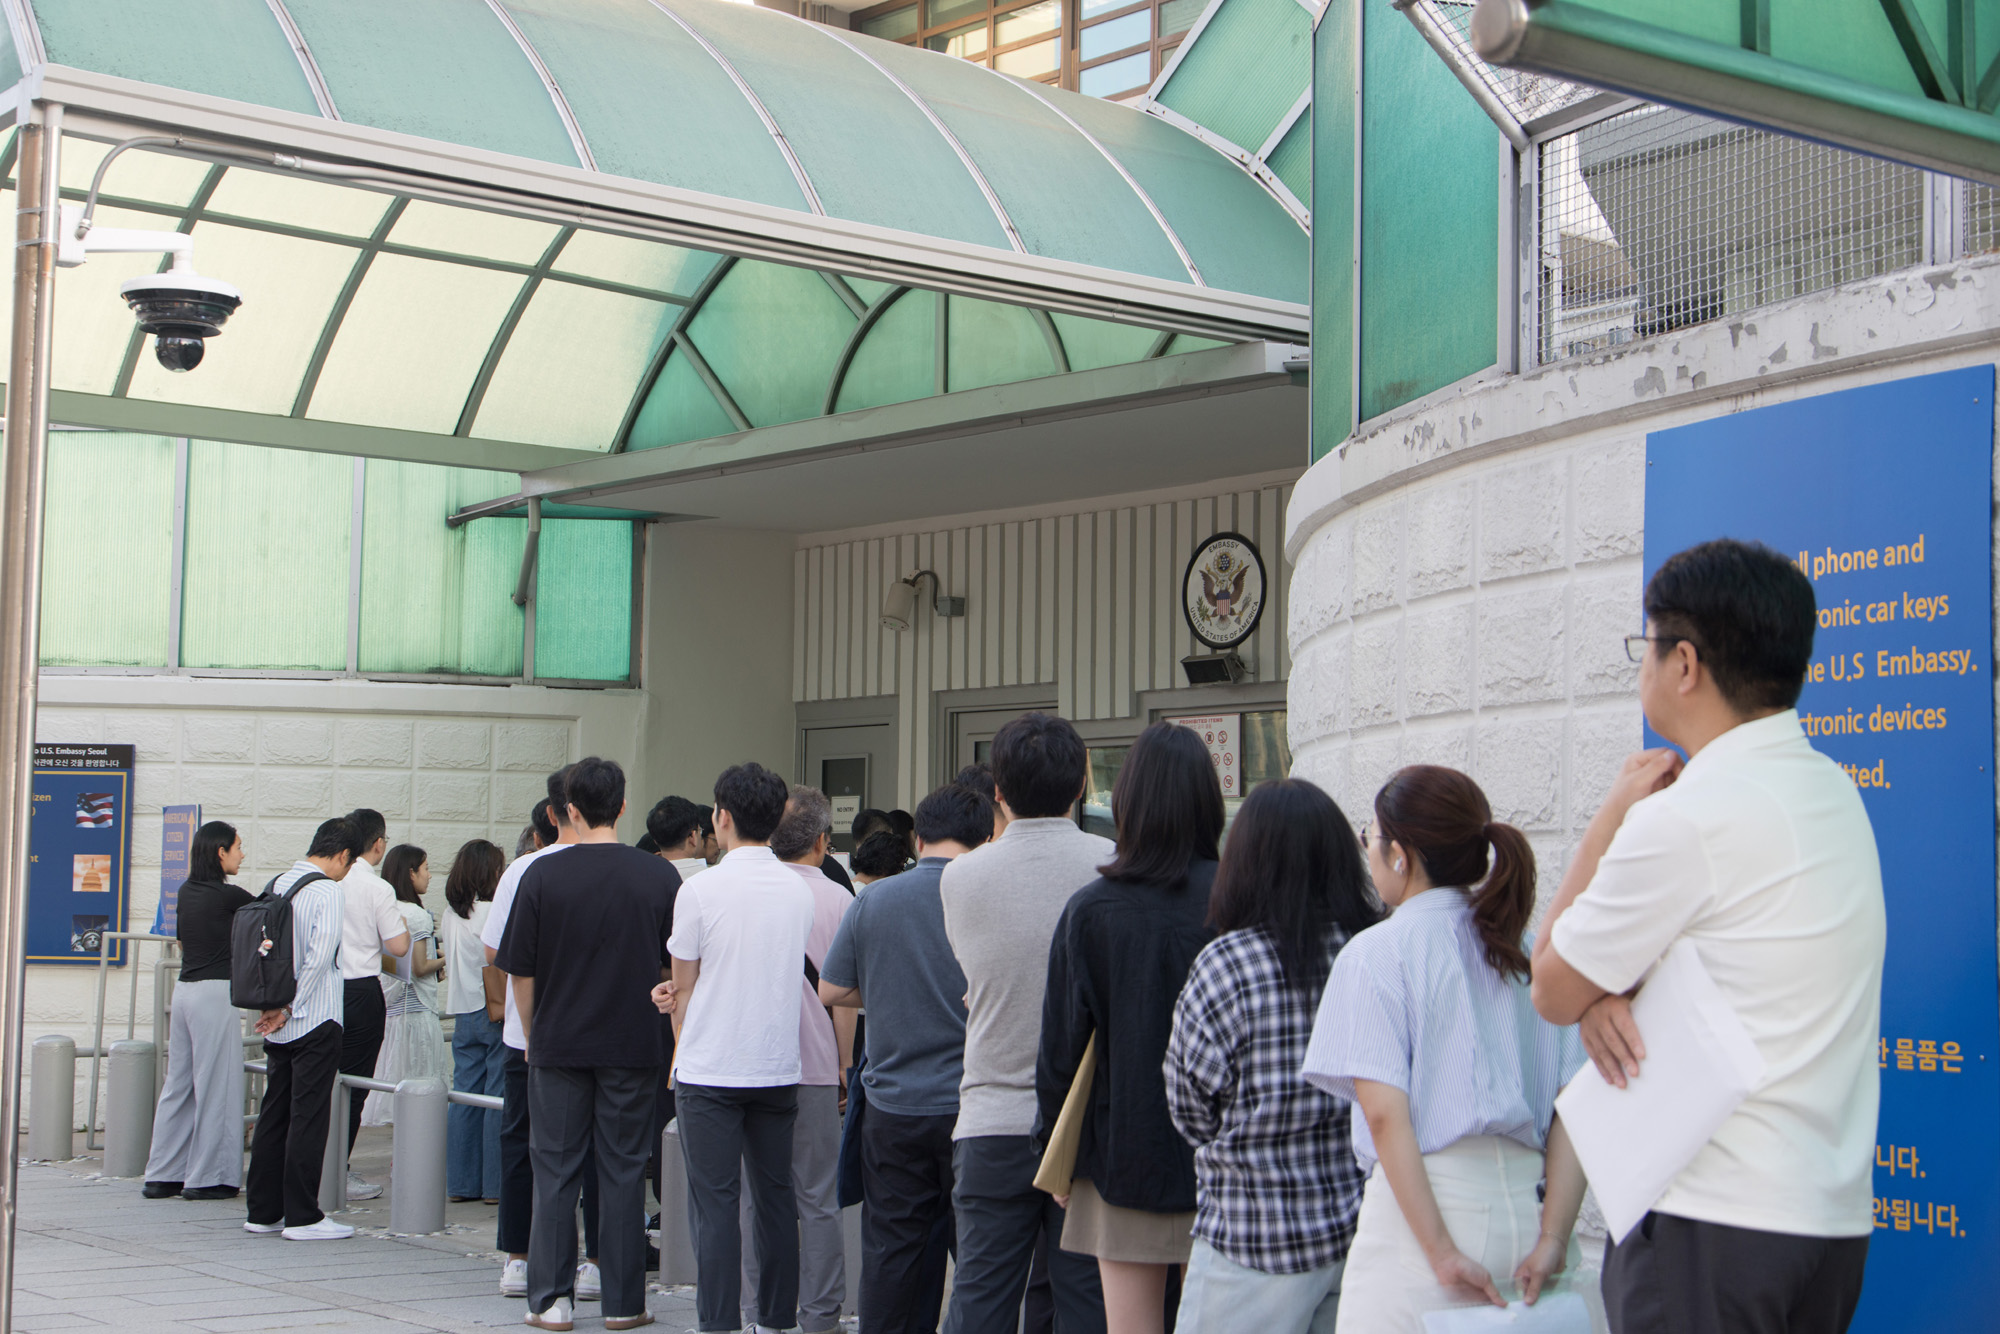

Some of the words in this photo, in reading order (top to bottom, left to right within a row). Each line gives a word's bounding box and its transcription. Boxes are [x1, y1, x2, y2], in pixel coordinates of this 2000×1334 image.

[1208, 541, 1240, 553] EMBASSY
[1813, 547, 1878, 581] phone
[1883, 533, 1924, 567] and
[1190, 606, 1205, 633] UNITED
[1205, 630, 1229, 641] STATES
[1229, 630, 1238, 639] OF
[1238, 601, 1259, 634] AMERICA
[1865, 600, 1898, 624] car
[1903, 591, 1949, 622] keys
[1830, 652, 1865, 682] U.S
[1877, 645, 1978, 677] Embassy.
[1868, 702, 1947, 733] devices
[40, 747, 55, 755] U.S.
[55, 747, 87, 756] Embassy
[87, 747, 108, 756] Seoul
[54, 758, 69, 767] 오신
[70, 758, 84, 767] 것을
[85, 759, 120, 768] 환영합니다
[1838, 758, 1891, 789] ted.
[164, 812, 188, 824] AMERICAN
[166, 831, 184, 842] CITIZEN
[164, 850, 185, 861] SERVICES
[1893, 1037, 1964, 1073] 물품은
[1876, 1144, 1926, 1178] 니다.
[1872, 1197, 1966, 1238] 안됩니다.
